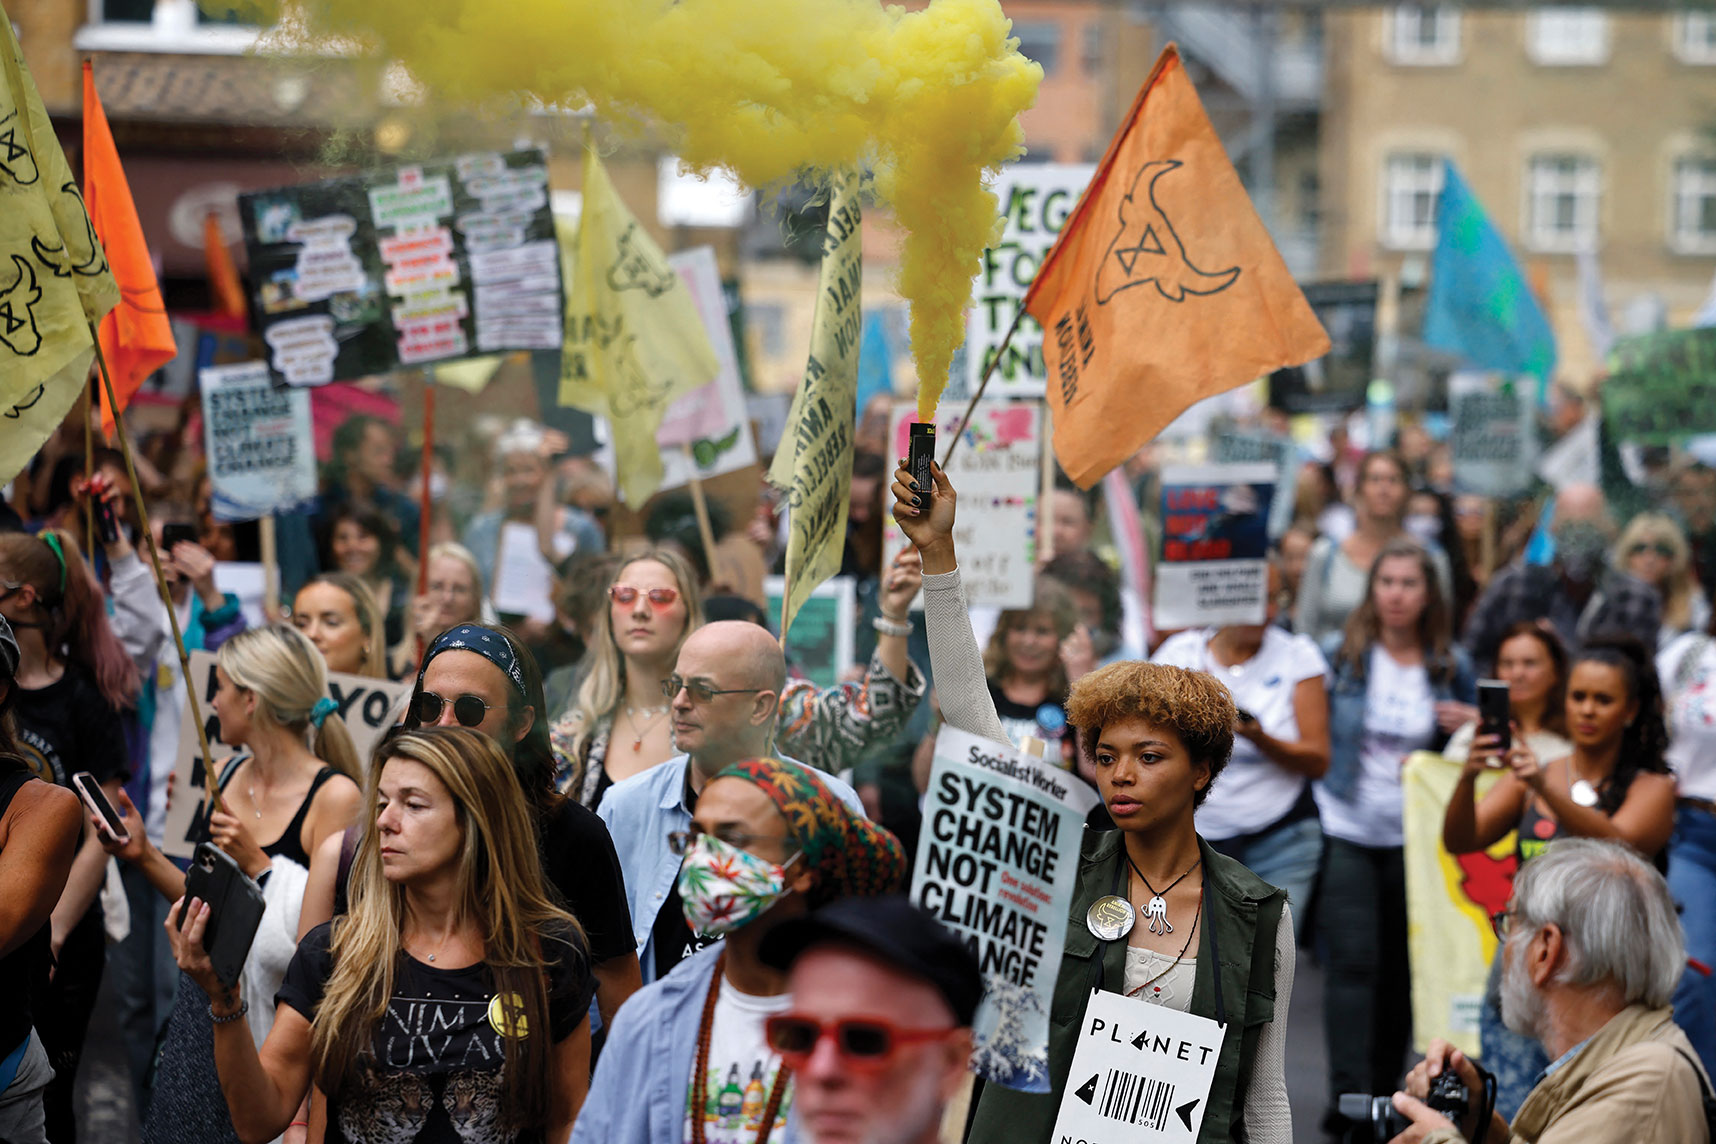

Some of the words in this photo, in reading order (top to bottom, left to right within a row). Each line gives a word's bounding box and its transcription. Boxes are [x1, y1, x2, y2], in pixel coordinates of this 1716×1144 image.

[985, 242, 1052, 288] FO
[328, 681, 398, 728] YO
[968, 745, 1030, 783] Socialist
[1031, 767, 1069, 801] Worker
[937, 772, 1060, 847] SYSTEM
[926, 843, 997, 894] NOT
[933, 810, 1059, 885] CHANGE
[921, 881, 1047, 958] CLIMATE
[381, 1003, 489, 1035] NIM
